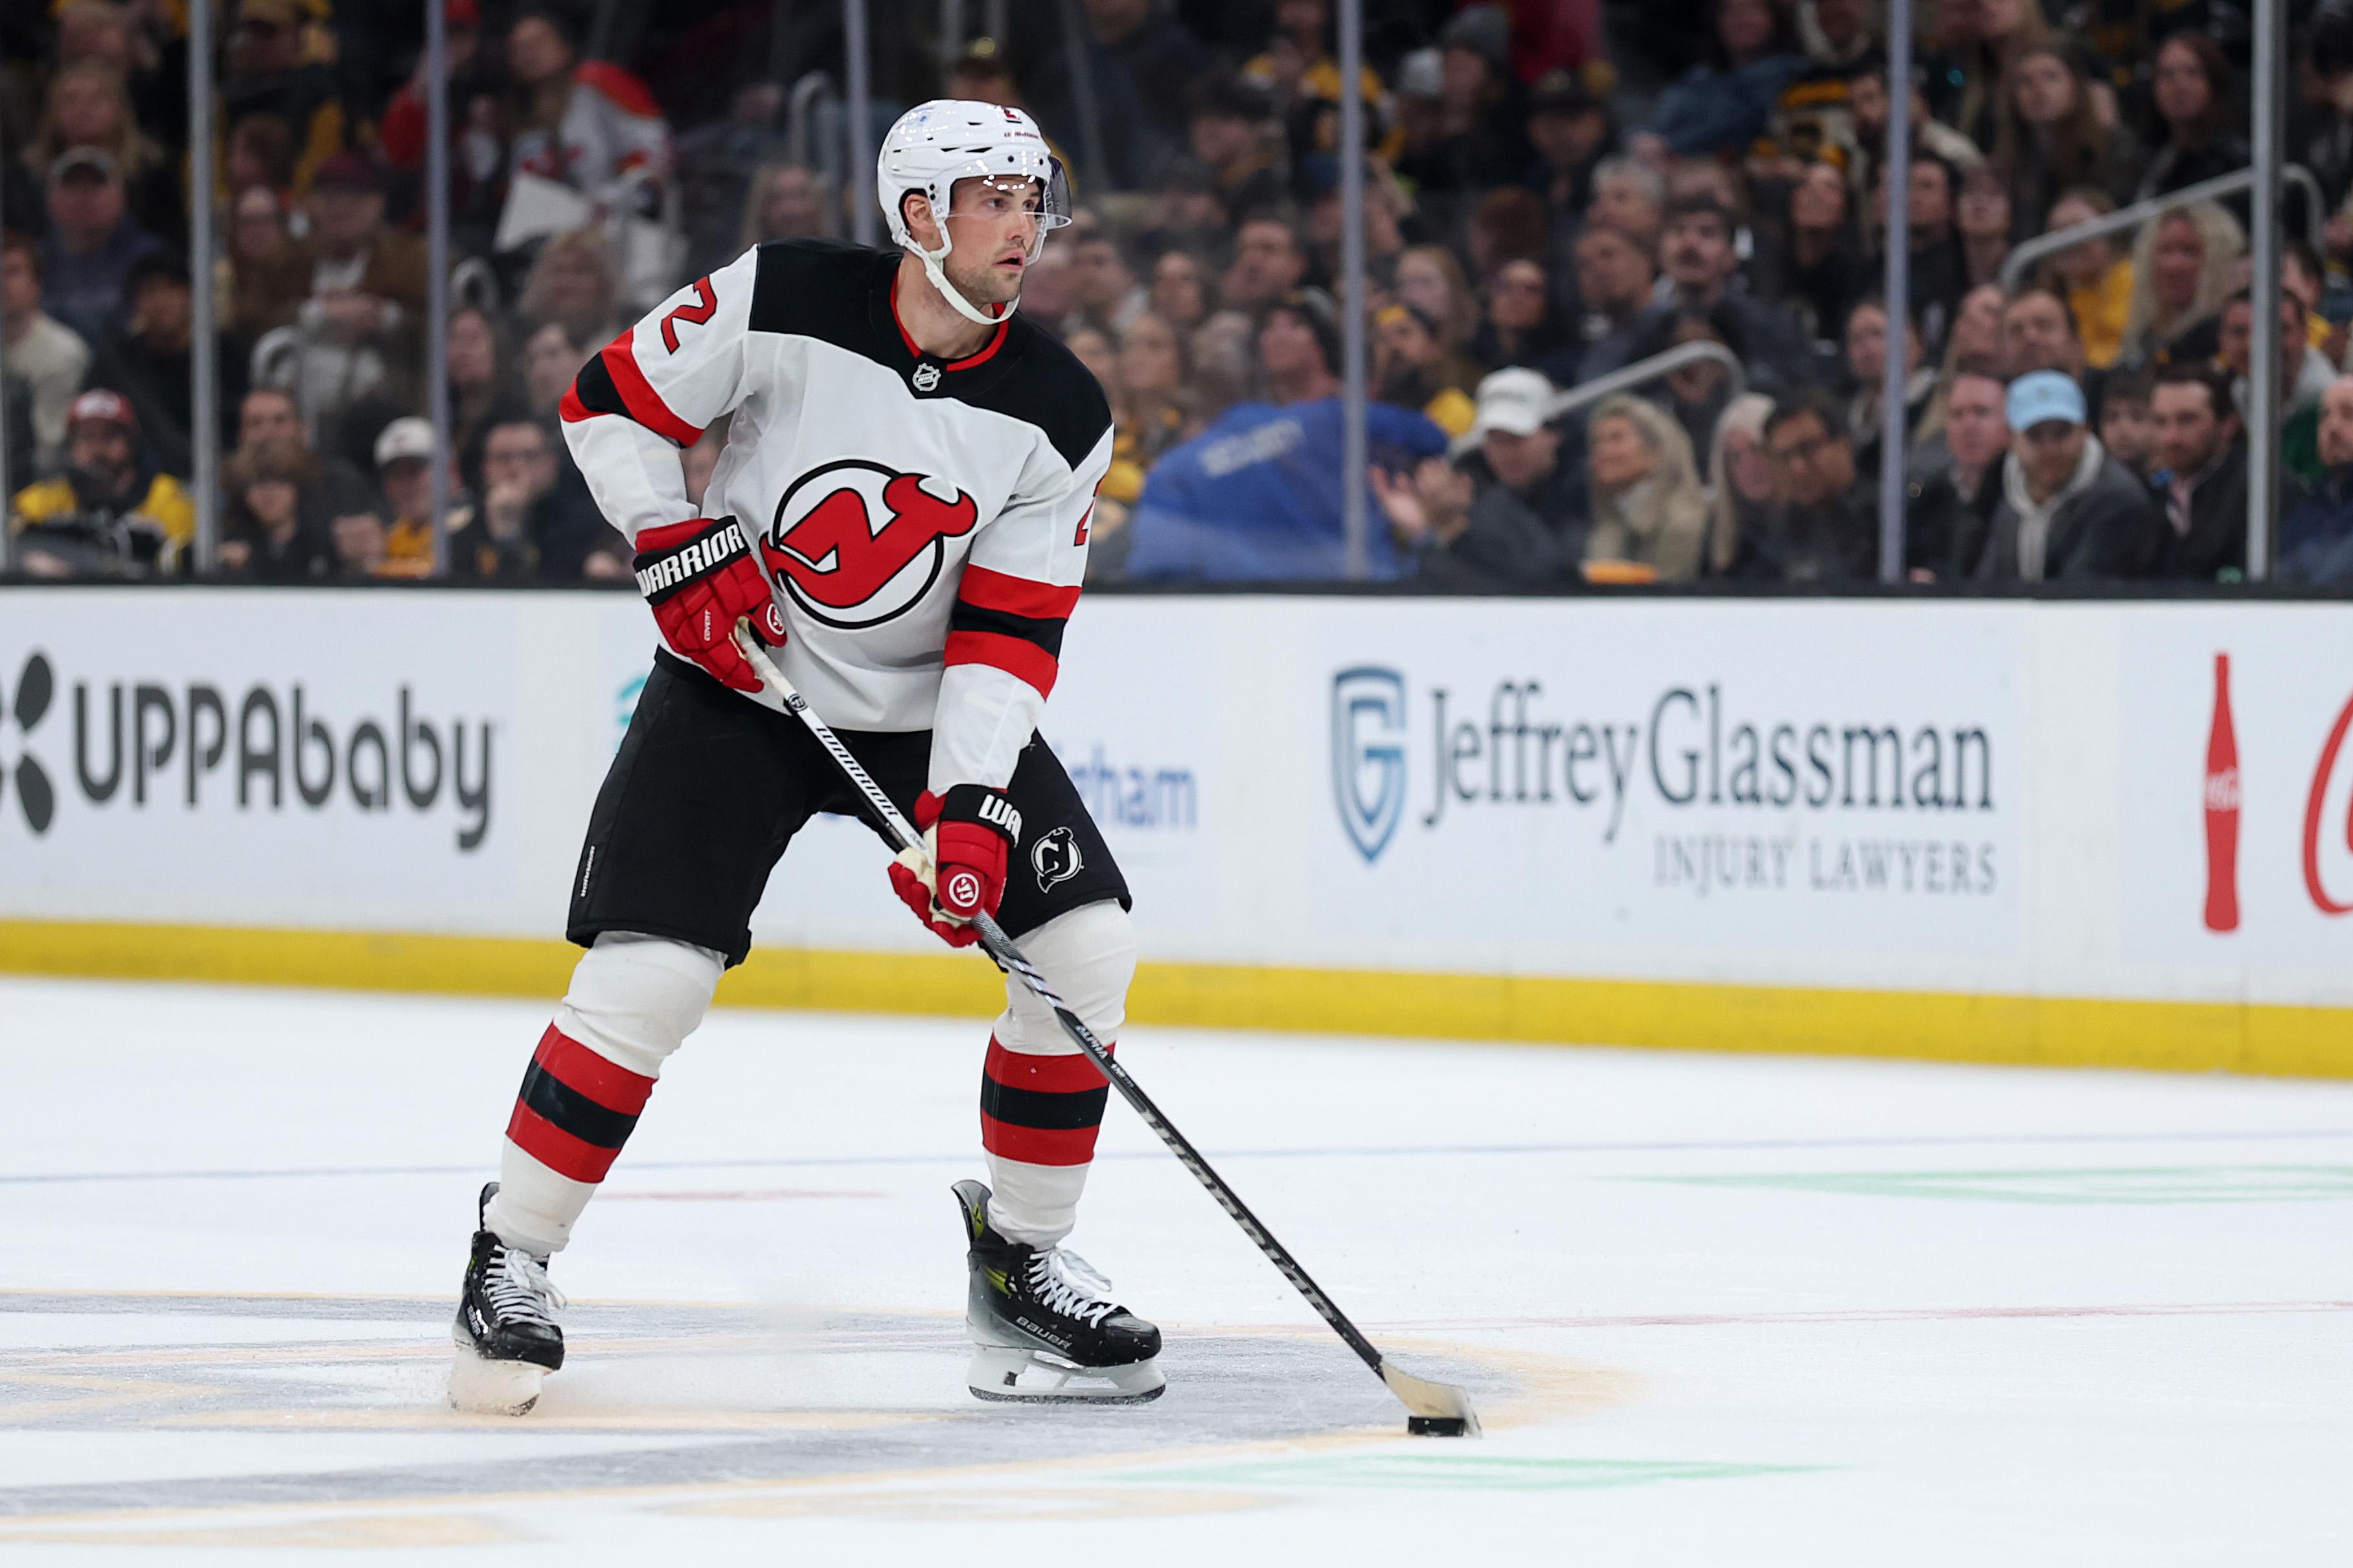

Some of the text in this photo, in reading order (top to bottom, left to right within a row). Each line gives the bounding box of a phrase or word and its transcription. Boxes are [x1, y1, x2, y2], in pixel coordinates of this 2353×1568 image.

[660, 275, 717, 355] 2
[74, 683, 492, 852] UPPAbaby
[1422, 680, 1997, 844] Jeffrey Glassman
[1653, 835, 1998, 898] INJURY LAWYERS
[1015, 1315, 1073, 1352] BAUER
